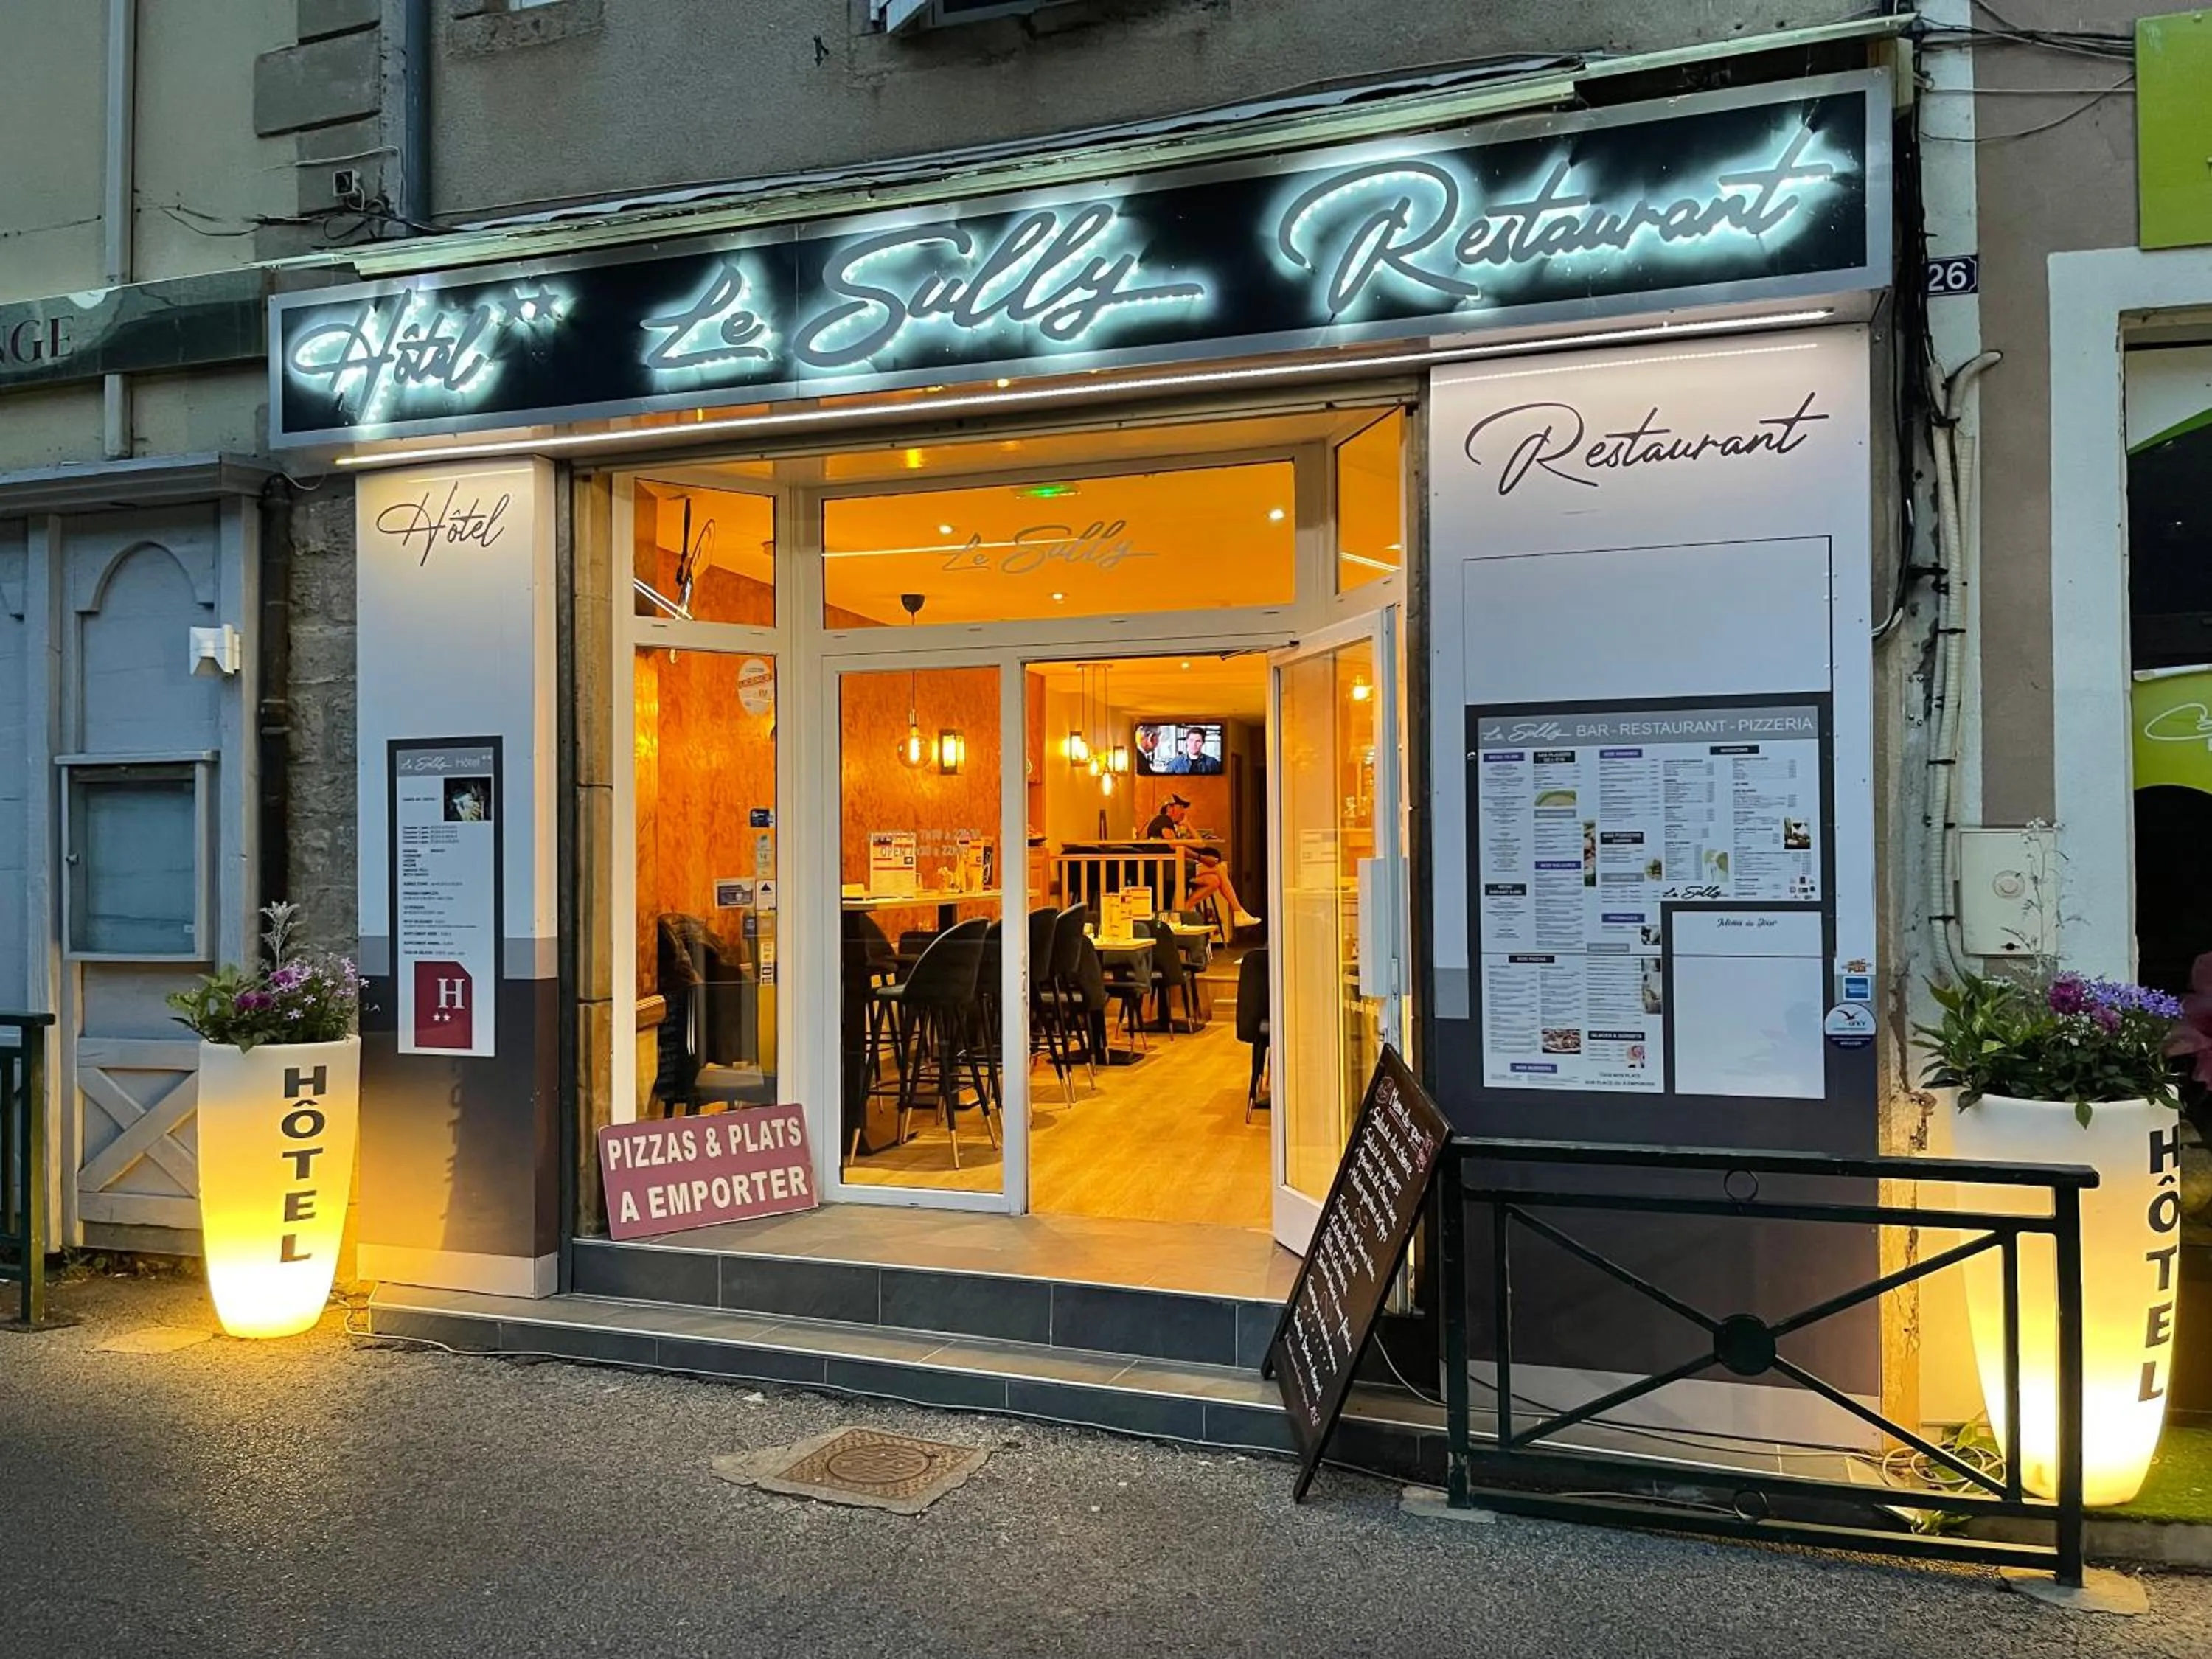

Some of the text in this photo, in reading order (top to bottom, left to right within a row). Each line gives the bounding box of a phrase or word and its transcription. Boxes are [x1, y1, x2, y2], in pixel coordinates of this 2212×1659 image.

[1278, 124, 1833, 317] Restaurant
[640, 204, 1206, 368] Le Sully
[1928, 262, 1967, 291] 26
[0, 316, 74, 364] GE
[292, 289, 487, 425] Hôtel
[1465, 392, 1829, 495] Restaurant
[376, 481, 510, 567] Hôtel
[939, 519, 1159, 574] Le Sully
[1576, 724, 1610, 737] BAR
[1620, 720, 1727, 737] RESTAURANT
[1738, 717, 1814, 732] PIZZERIA
[437, 978, 465, 1009] H
[280, 1065, 327, 1262] HÔTEL
[607, 1116, 801, 1171] PIZZAS & PLATS
[620, 1166, 809, 1224] A EMPORTER
[2138, 1124, 2180, 1402] HÔTEL
